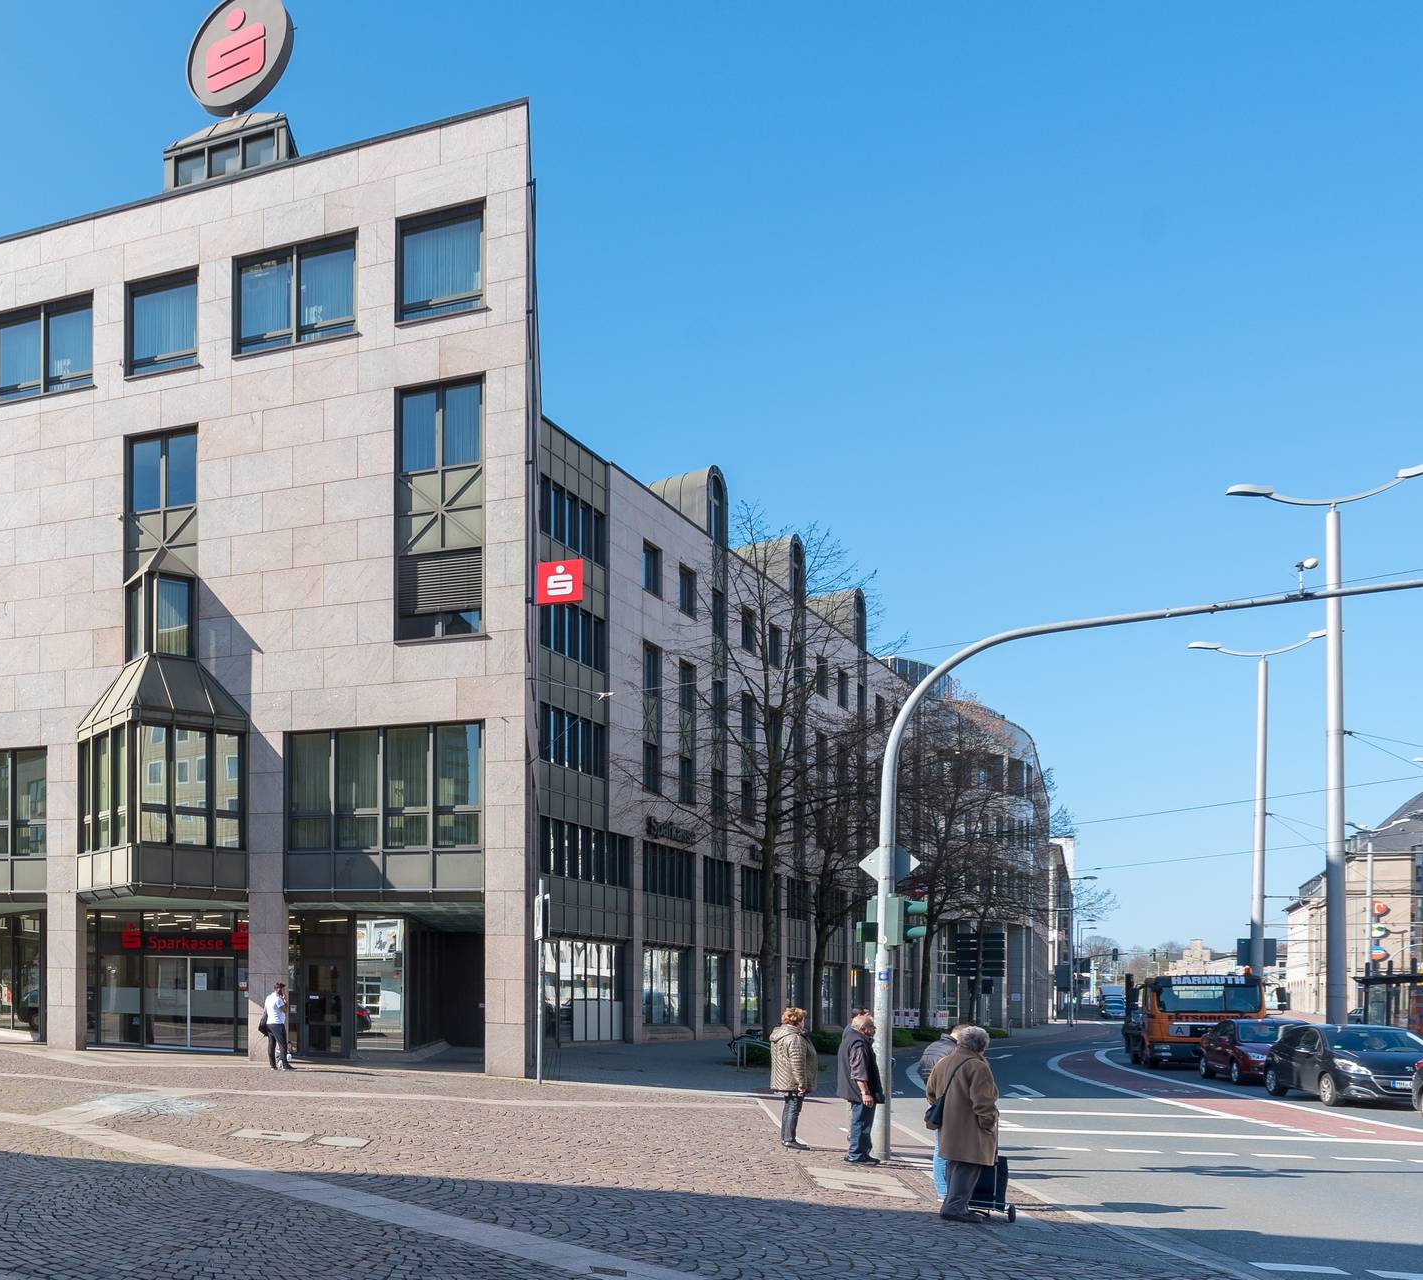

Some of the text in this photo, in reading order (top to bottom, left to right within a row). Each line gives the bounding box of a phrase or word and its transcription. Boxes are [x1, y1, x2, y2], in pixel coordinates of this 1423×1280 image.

[147, 935, 223, 952] Sparkasse
[1171, 975, 1246, 985] HARMUTH
[1175, 1026, 1184, 1035] A
